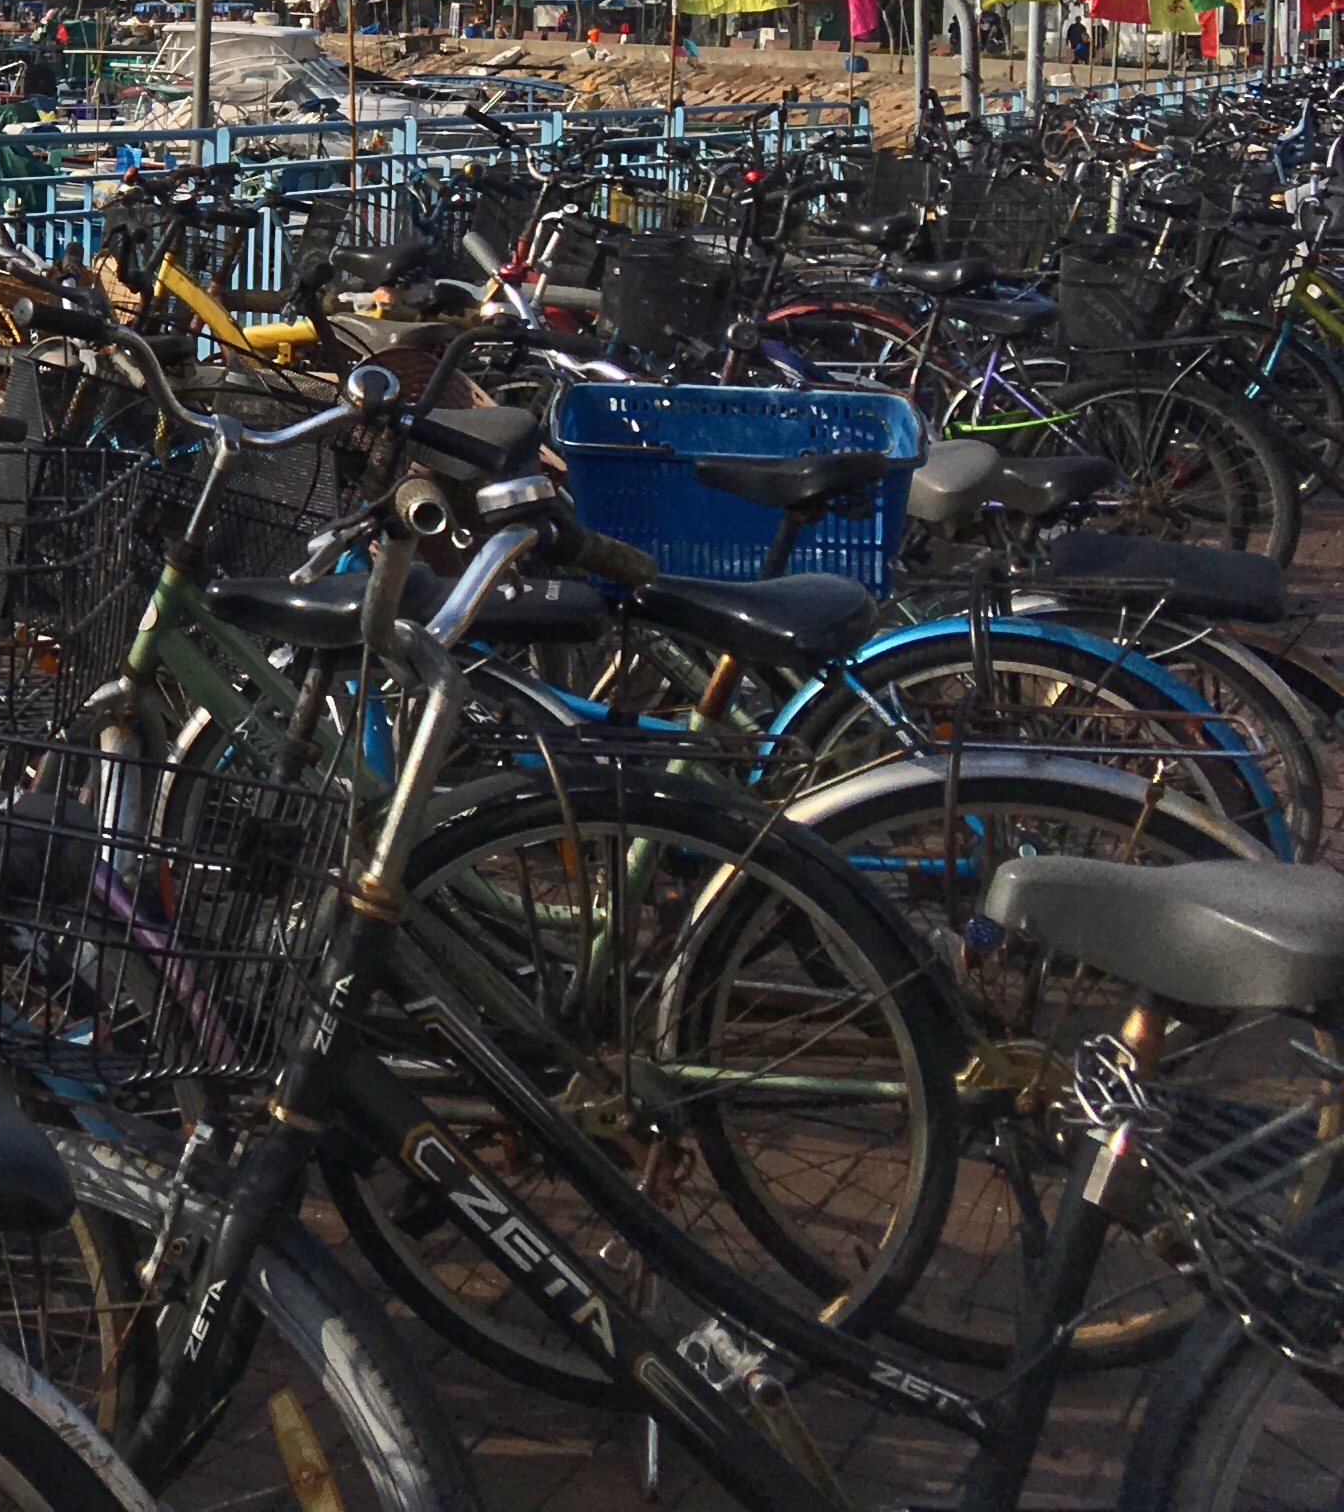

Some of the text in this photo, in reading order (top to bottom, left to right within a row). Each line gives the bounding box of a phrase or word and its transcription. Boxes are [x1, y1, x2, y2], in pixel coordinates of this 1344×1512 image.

[312, 973, 356, 1056] ZETA
[448, 1174, 616, 1359] ZETA
[182, 1278, 228, 1363] ZETA
